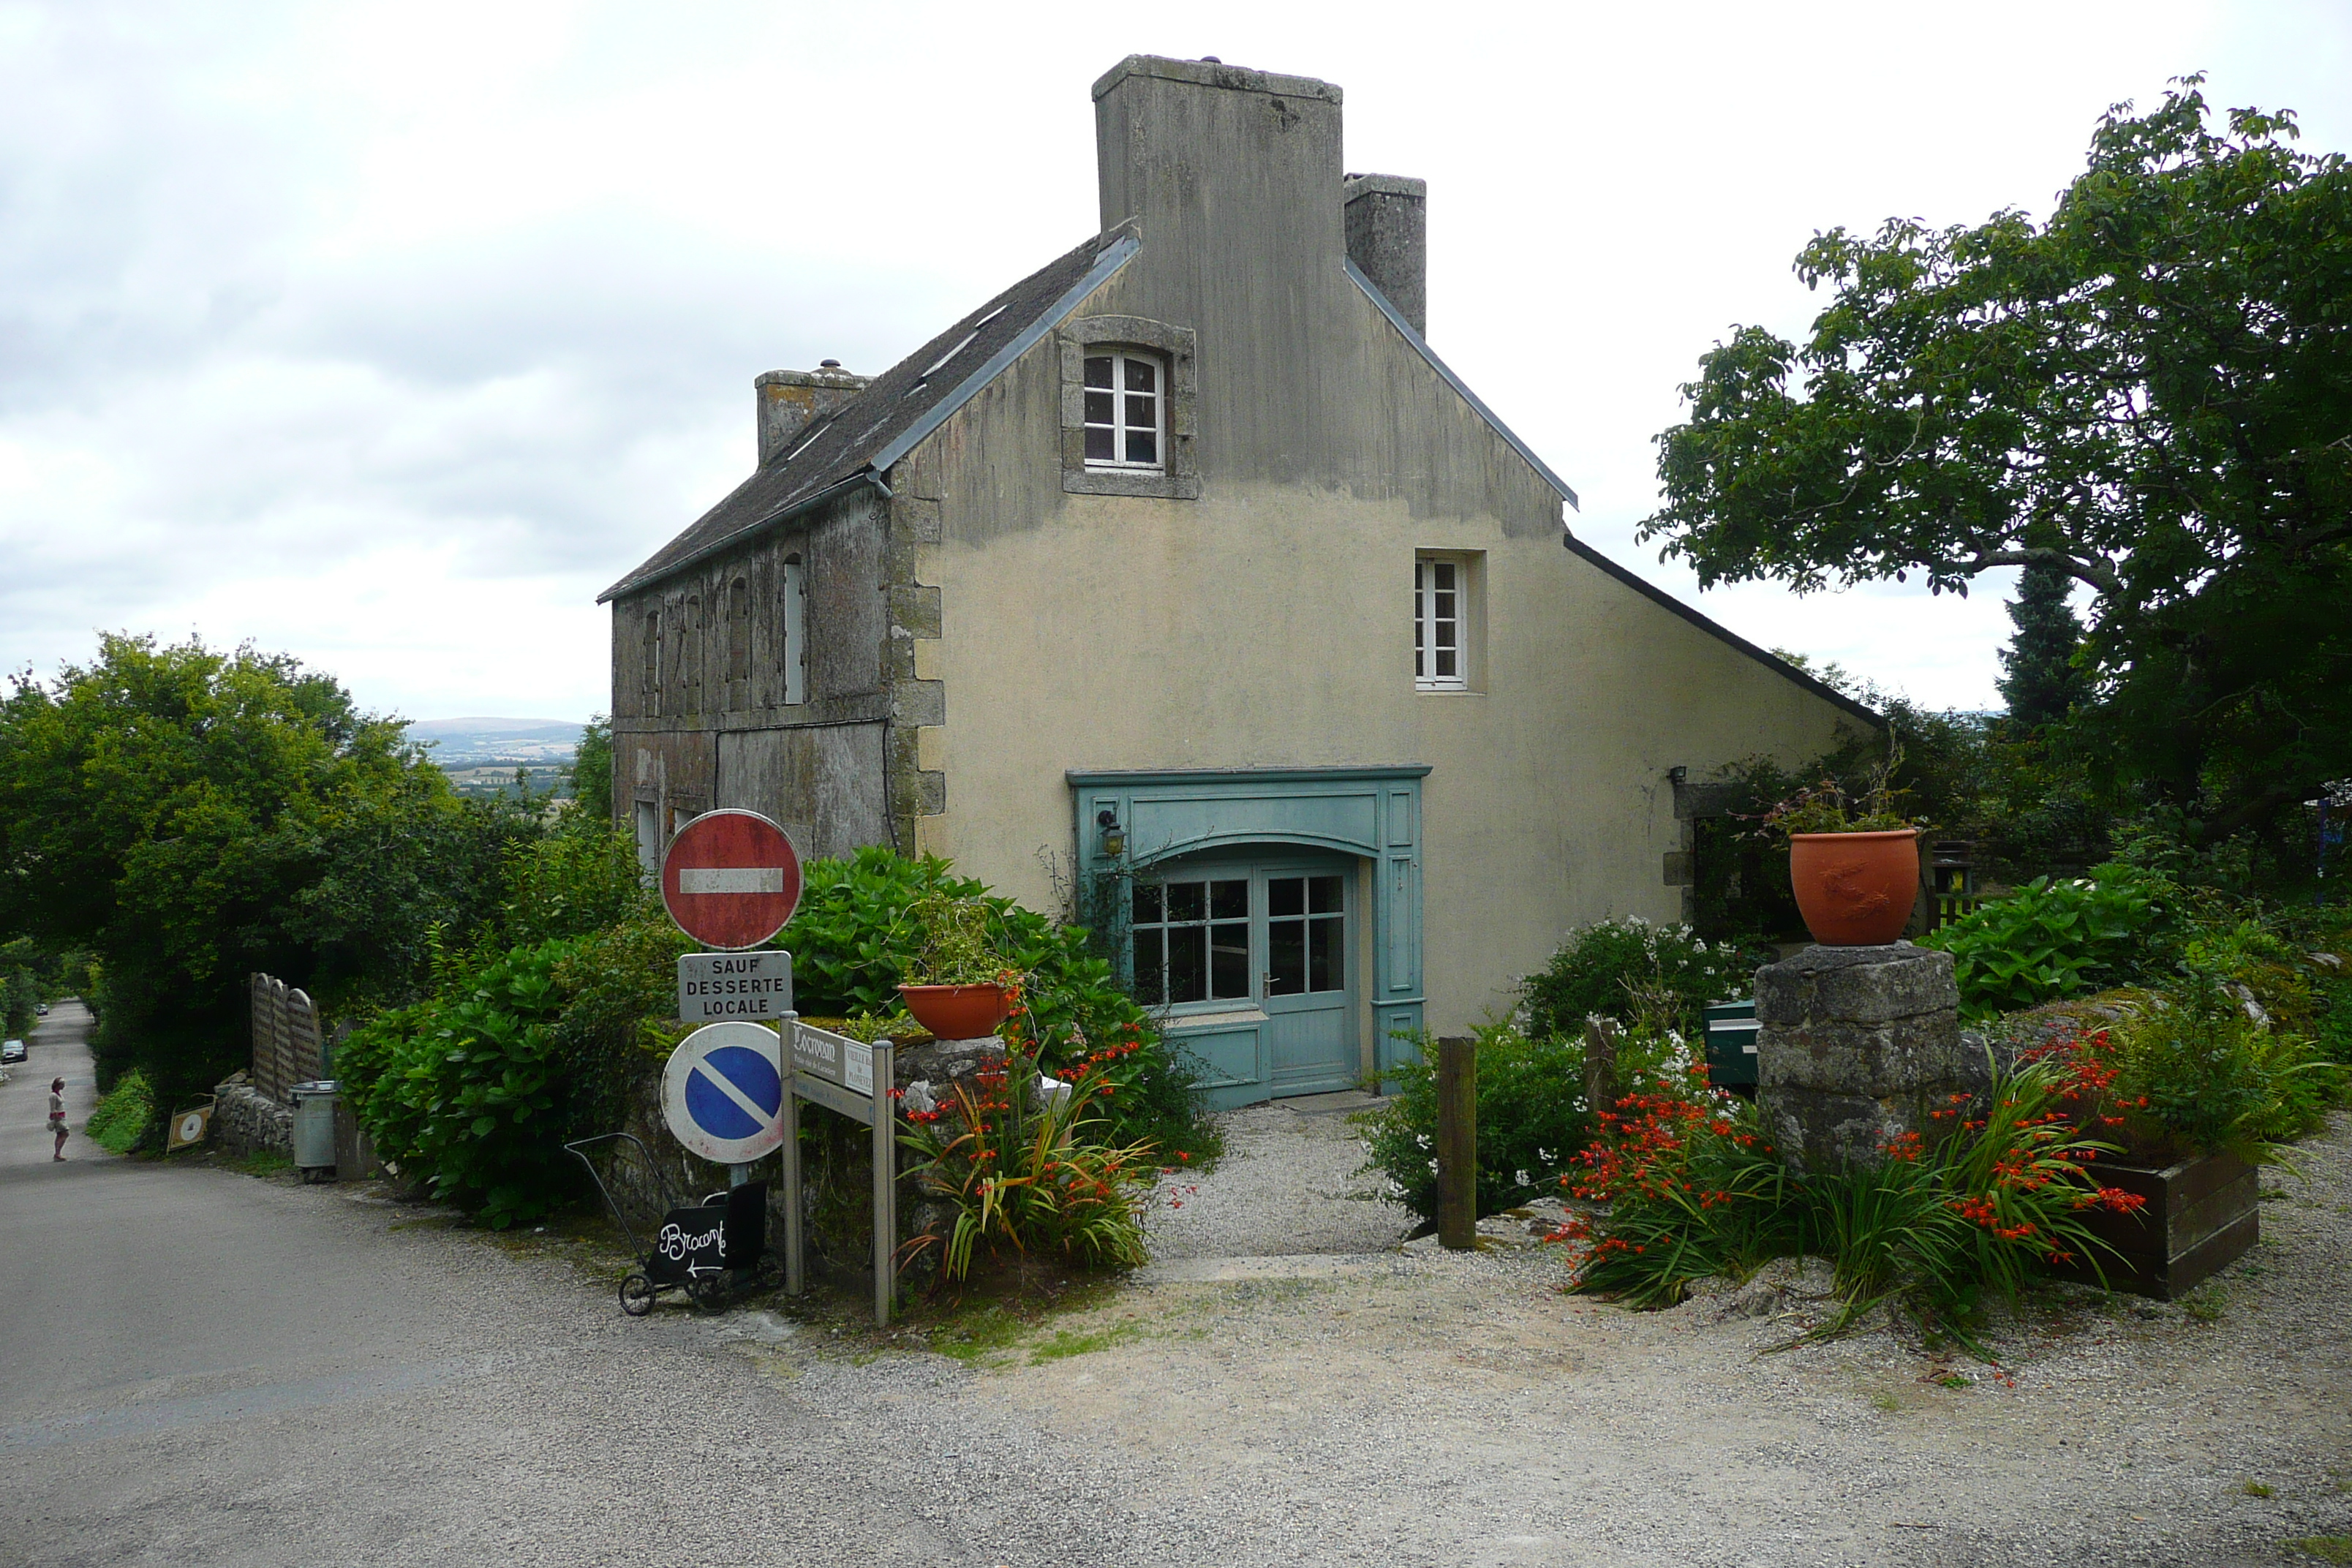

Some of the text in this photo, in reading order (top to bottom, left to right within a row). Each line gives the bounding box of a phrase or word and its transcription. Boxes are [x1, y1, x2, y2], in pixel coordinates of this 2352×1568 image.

[712, 959, 758, 974] SAUF
[687, 978, 783, 995] DESSERTE
[704, 999, 768, 1015] LOCALE
[794, 1025, 835, 1063] Locronan
